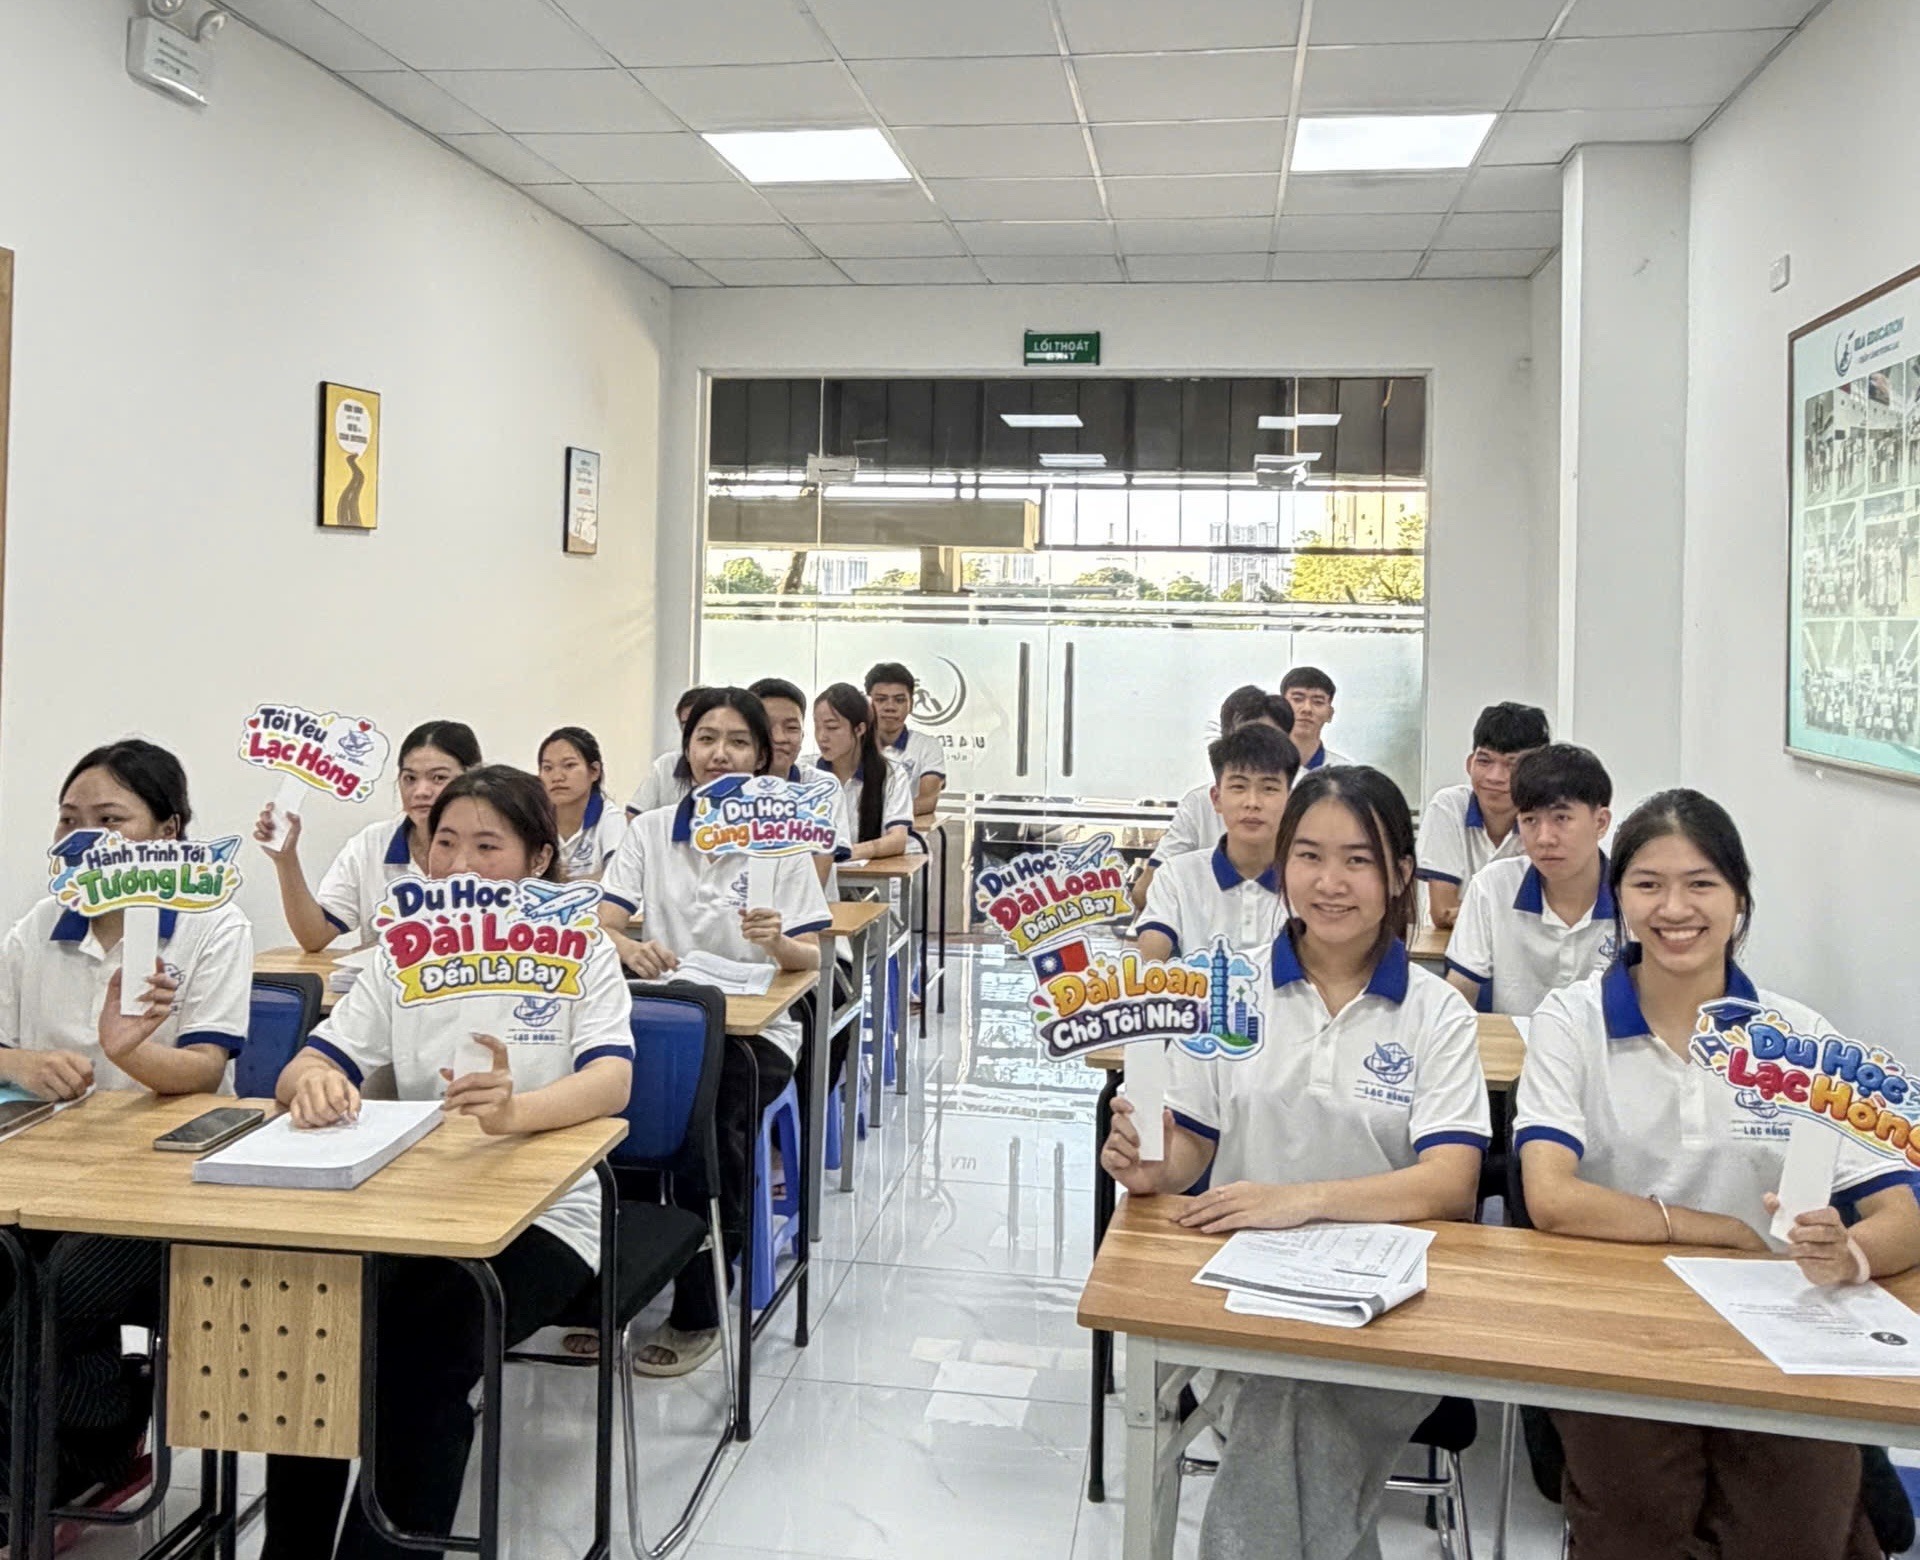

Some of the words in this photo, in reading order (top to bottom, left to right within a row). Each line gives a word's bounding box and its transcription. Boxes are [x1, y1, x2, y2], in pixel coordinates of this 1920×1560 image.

[1034, 338, 1052, 351] LỐI
[1054, 339, 1090, 351] THOÁT
[260, 708, 292, 732] Tôi
[294, 713, 328, 743] Yêu
[249, 732, 297, 765] Lạc
[724, 799, 755, 822] Du
[756, 798, 796, 820] Học
[751, 820, 785, 845] Lạc
[86, 844, 133, 869] Hành
[135, 843, 178, 862] Trình
[181, 844, 205, 863] Tới
[77, 865, 177, 905] Tương
[180, 863, 225, 896] Lai
[980, 870, 1017, 897] Du
[1014, 854, 1057, 879] Học
[392, 881, 445, 917] Du
[450, 879, 513, 914] Học
[989, 881, 1048, 931] Đài
[1044, 867, 1122, 902] Loan
[1057, 901, 1082, 925] Là
[1080, 895, 1116, 916] Bay
[386, 914, 475, 969] Đài
[482, 913, 588, 960] Loan
[421, 956, 476, 992] Đến
[479, 957, 514, 983] Là
[516, 956, 567, 992] Bay
[1047, 964, 1121, 1017] Đài
[1122, 955, 1208, 998] Loan
[1052, 1014, 1103, 1049] Chờ
[1103, 1004, 1142, 1035] Tôi
[1147, 1001, 1196, 1030] Nhé
[1728, 1046, 1811, 1102] Lạc
[1748, 1023, 1818, 1070] Du
[1822, 1039, 1909, 1105] Học
